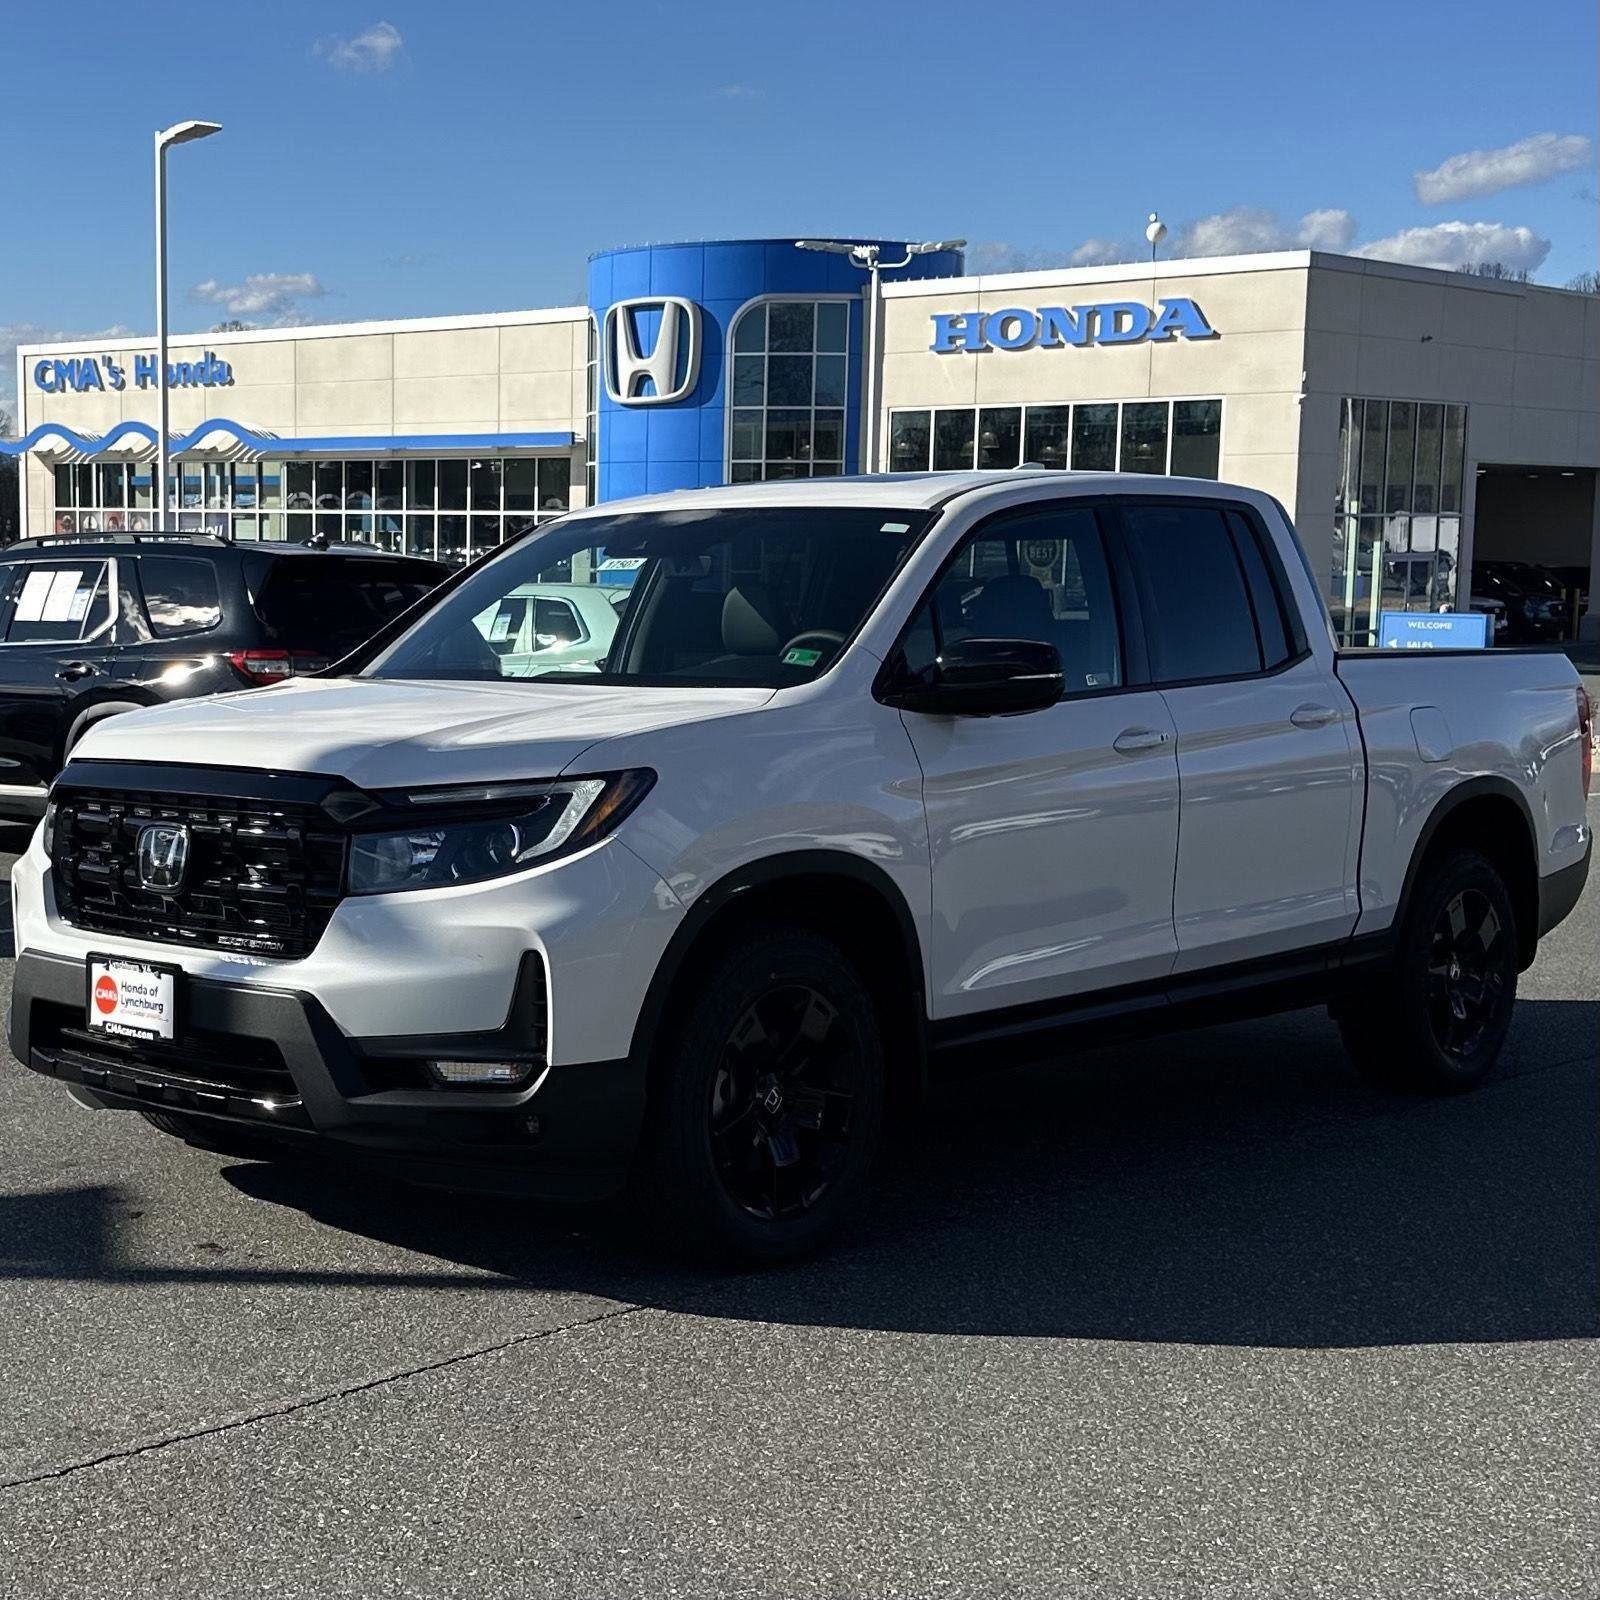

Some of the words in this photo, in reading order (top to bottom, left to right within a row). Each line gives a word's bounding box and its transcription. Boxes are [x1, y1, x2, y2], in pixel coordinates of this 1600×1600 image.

[930, 297, 1216, 353] HONDA
[34, 354, 125, 393] CMA's
[1407, 620, 1453, 630] WELCOME
[121, 980, 148, 995] Honda
[149, 986, 159, 997] of
[120, 995, 164, 1014] Lynchburg
